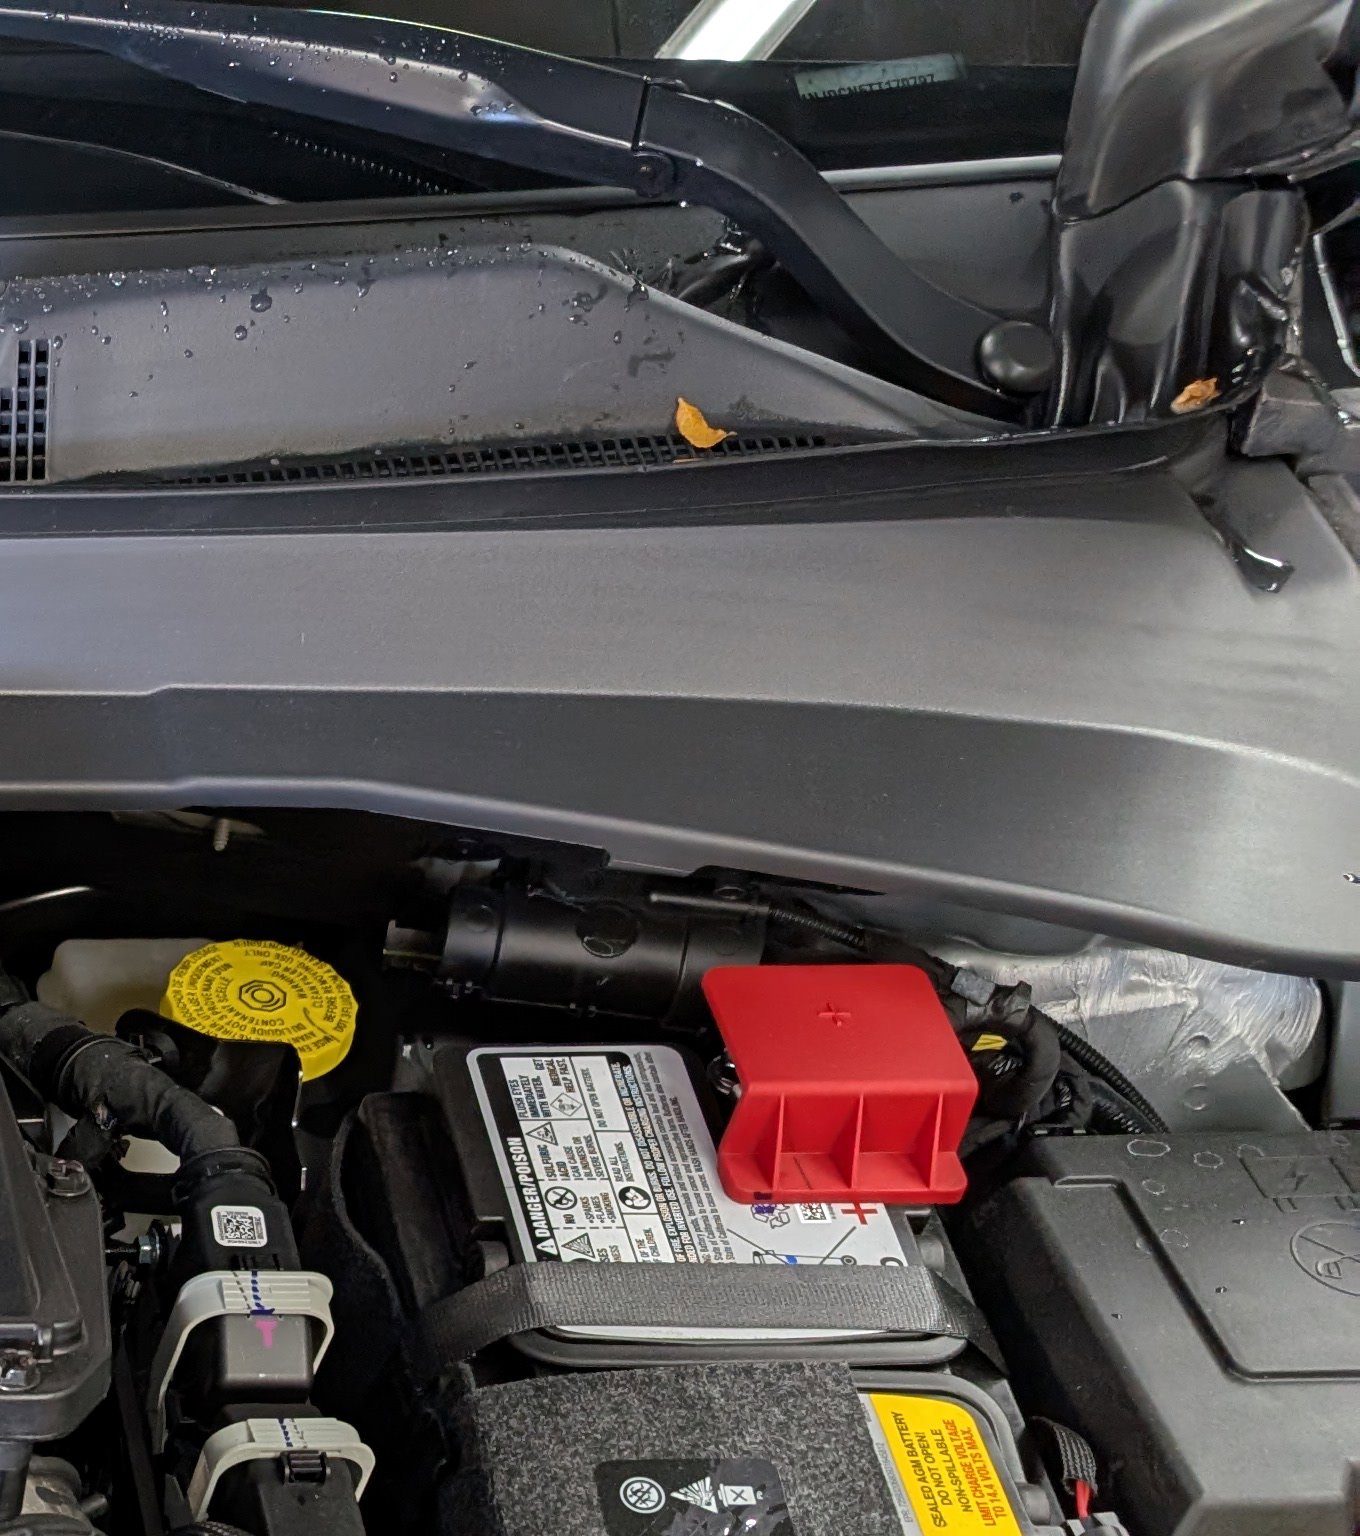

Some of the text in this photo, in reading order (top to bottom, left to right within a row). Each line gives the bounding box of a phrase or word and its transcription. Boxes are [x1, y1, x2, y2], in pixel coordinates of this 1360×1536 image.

[532, 1058, 544, 1069] GET
[544, 1058, 561, 1085] MEDICAL
[518, 1075, 540, 1117] IMMEDIATELY
[561, 1077, 575, 1092] HELP
[508, 1079, 528, 1117] FLUSH EYES
[538, 1101, 551, 1116] WITH
[588, 1093, 600, 1106] OPEN
[622, 1097, 632, 1105] OR
[593, 1108, 603, 1118] NOT
[636, 1107, 654, 1137] CHARGING
[625, 1106, 647, 1146] DISASSEMBLE
[639, 1148, 651, 1159] NOT
[647, 1138, 663, 1160] PROPER
[683, 1139, 698, 1156] HANDS
[537, 1145, 556, 1176] SULFURIC
[555, 1161, 569, 1176] ACID
[563, 1146, 581, 1176] CAN CAUSE
[574, 1146, 592, 1176] BLINDNESS
[589, 1155, 604, 1176] SEVERE
[608, 1156, 623, 1181] READ ALL
[643, 1160, 654, 1169] DO
[690, 1157, 703, 1171] WASH
[654, 1162, 671, 1186] FOLLOW
[506, 1137, 551, 1237] DANGER/POISON
[654, 1193, 665, 1201] OR
[562, 1213, 575, 1224] NO
[657, 1203, 677, 1235] EXPLOSION
[668, 1201, 687, 1230] INVERTED
[679, 1231, 691, 1243] FOR
[890, 1411, 918, 1456] BATTERY
[909, 1460, 928, 1482] AGM
[914, 1432, 952, 1504] DO NOT OPEN!
[930, 1429, 973, 1511] NON-SPILLABLE
[942, 1419, 996, 1525] LIMIT CHARGE VOLTAGE
[959, 1427, 1007, 1517] TO 14.4 VOLTS MAX.
[919, 1485, 947, 1526] SEALED
